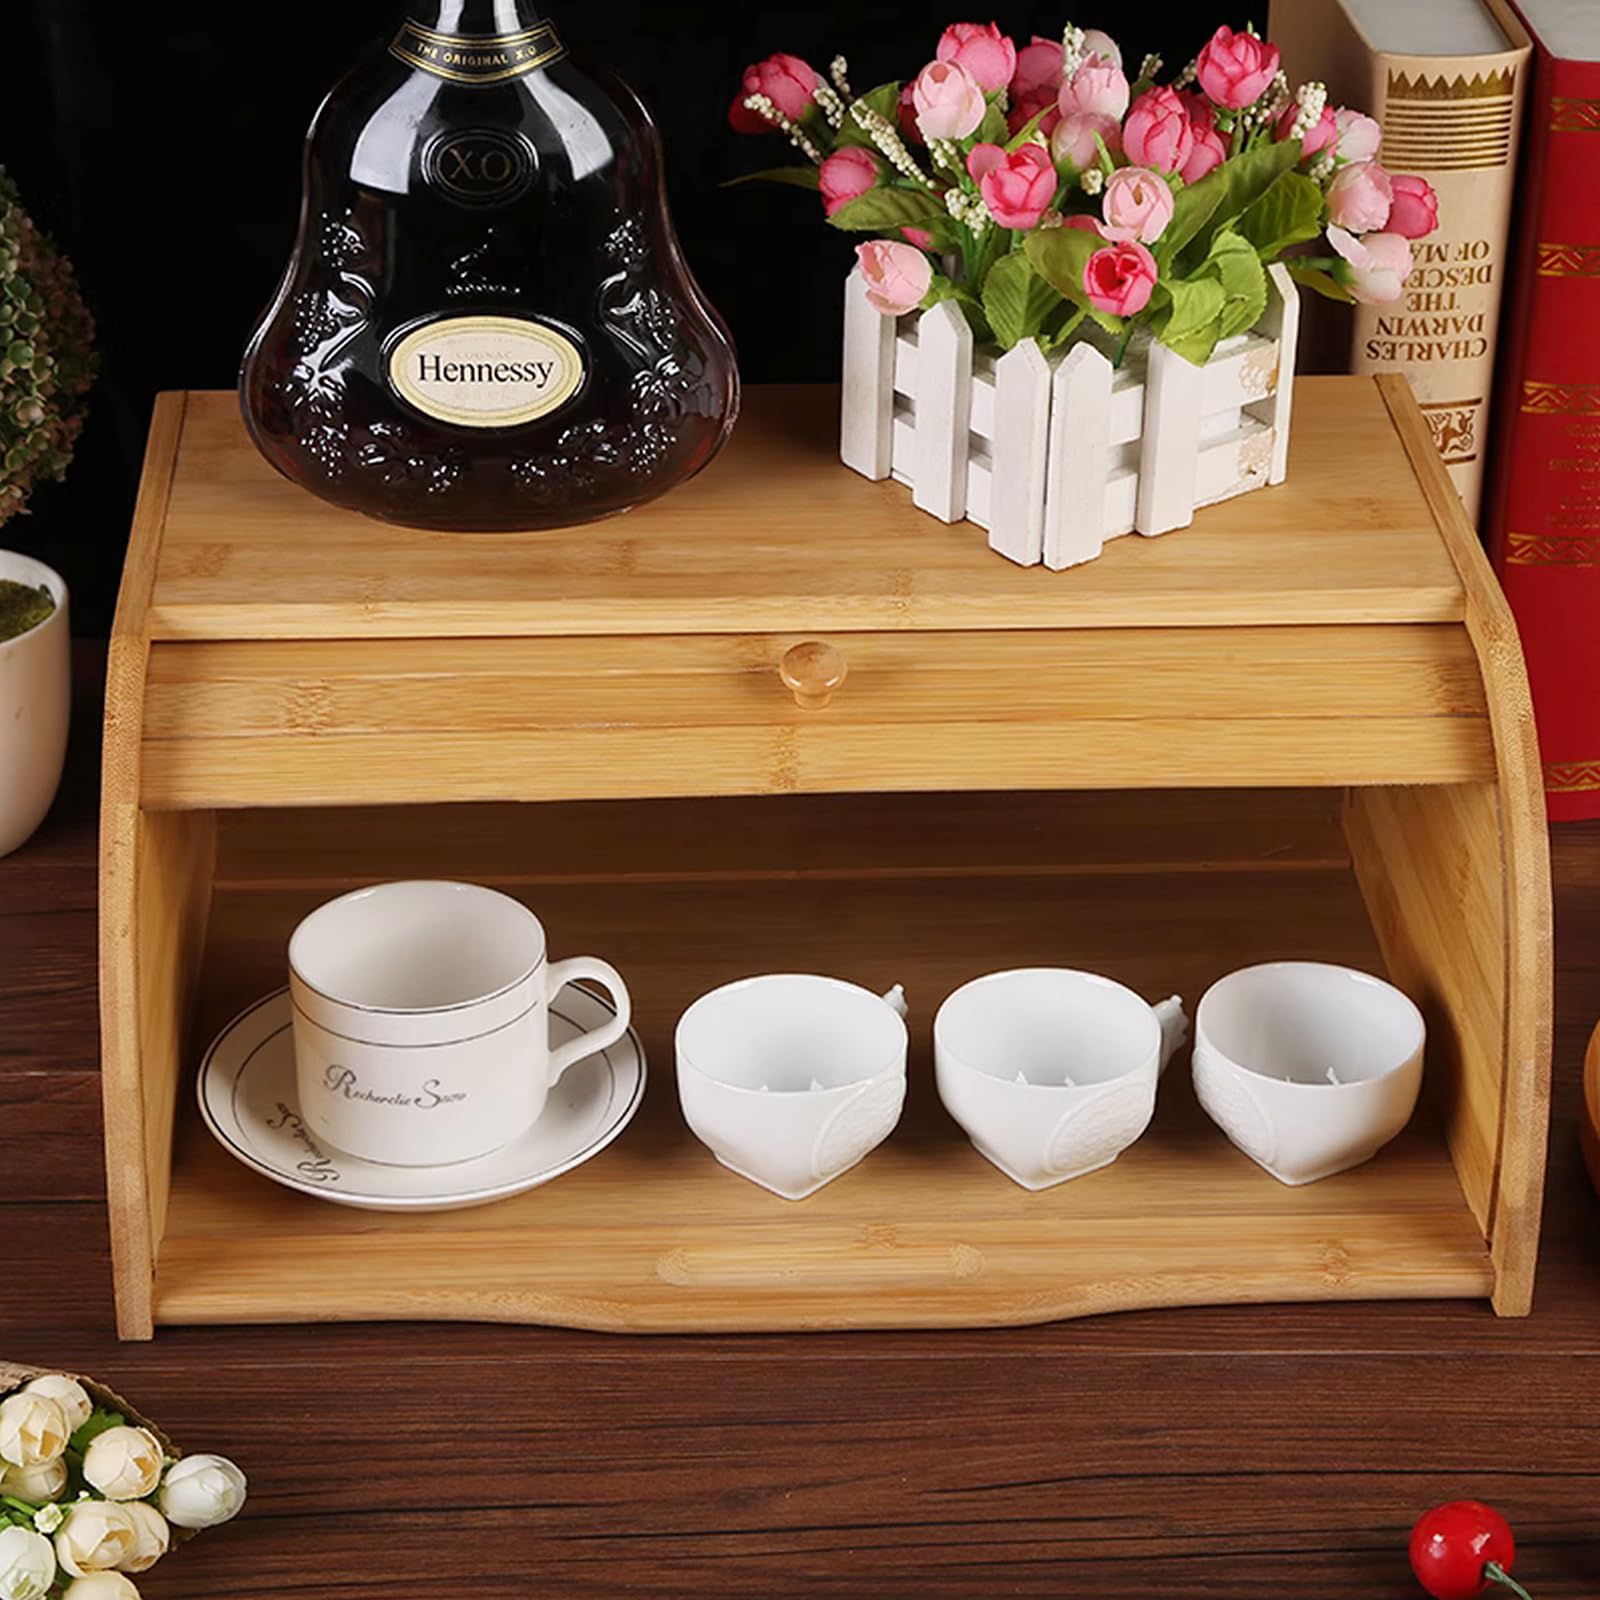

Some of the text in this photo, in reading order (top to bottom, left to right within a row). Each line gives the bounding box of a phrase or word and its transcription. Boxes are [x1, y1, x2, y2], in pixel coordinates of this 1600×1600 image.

[416, 42, 438, 59] THE
[443, 51, 509, 66] ORIGINAL
[1409, 240, 1490, 262] OF MA
[1401, 264, 1493, 288] DESCE
[1406, 292, 1460, 312] THE
[1376, 314, 1485, 337] DARWIN
[1365, 338, 1487, 362] CHARLES
[417, 353, 555, 390] Hennessy
